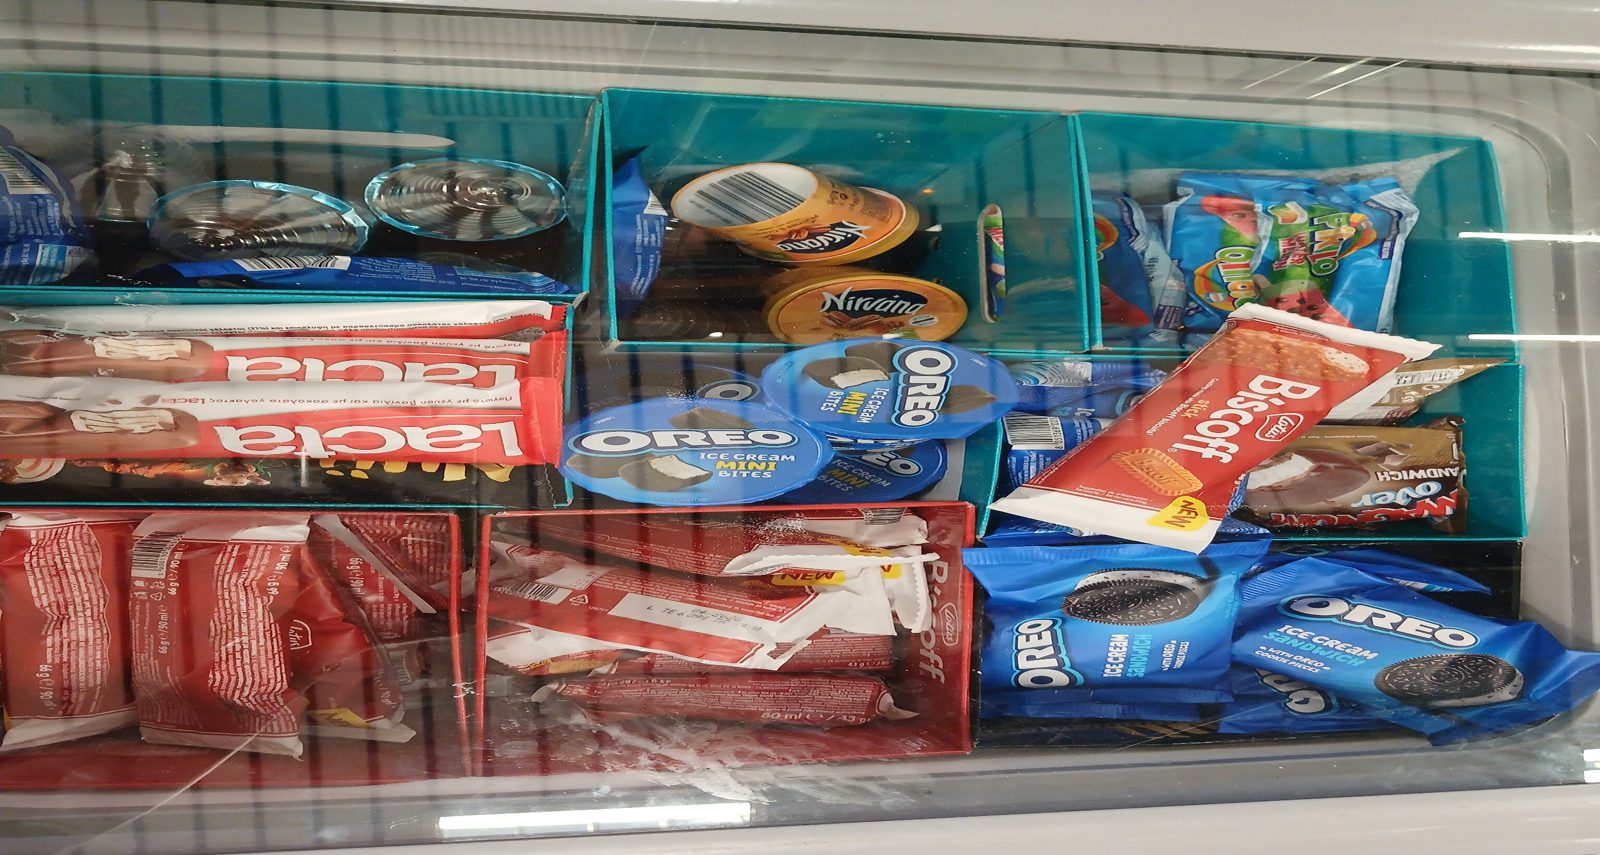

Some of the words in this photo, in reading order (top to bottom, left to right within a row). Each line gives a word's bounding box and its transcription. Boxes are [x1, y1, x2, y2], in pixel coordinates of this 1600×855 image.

[775, 220, 872, 252] Nirvana
[819, 286, 927, 316] Nirvana
[225, 355, 516, 389] Lacta
[899, 348, 952, 427] OREO
[820, 389, 845, 412] BITES
[837, 391, 867, 416] MINI
[1172, 374, 1321, 464] Biscoff
[1265, 415, 1295, 439] Lotus
[212, 420, 523, 459] Lacta
[580, 430, 794, 452] OREO
[699, 451, 730, 460] ICE
[715, 460, 777, 471] MINI
[718, 470, 773, 478] BITES
[817, 474, 853, 492] BITES
[826, 468, 871, 488] MINI
[1375, 465, 1459, 481] ANDWICH
[1350, 480, 1442, 508] over
[1164, 499, 1199, 528] NEW
[1276, 624, 1316, 640] ICE
[1290, 597, 1477, 647] OREO
[1017, 619, 1070, 689] OREO
[1268, 647, 1293, 659] WITH
[1293, 655, 1325, 668] OREO
[1103, 663, 1124, 677] ICE
